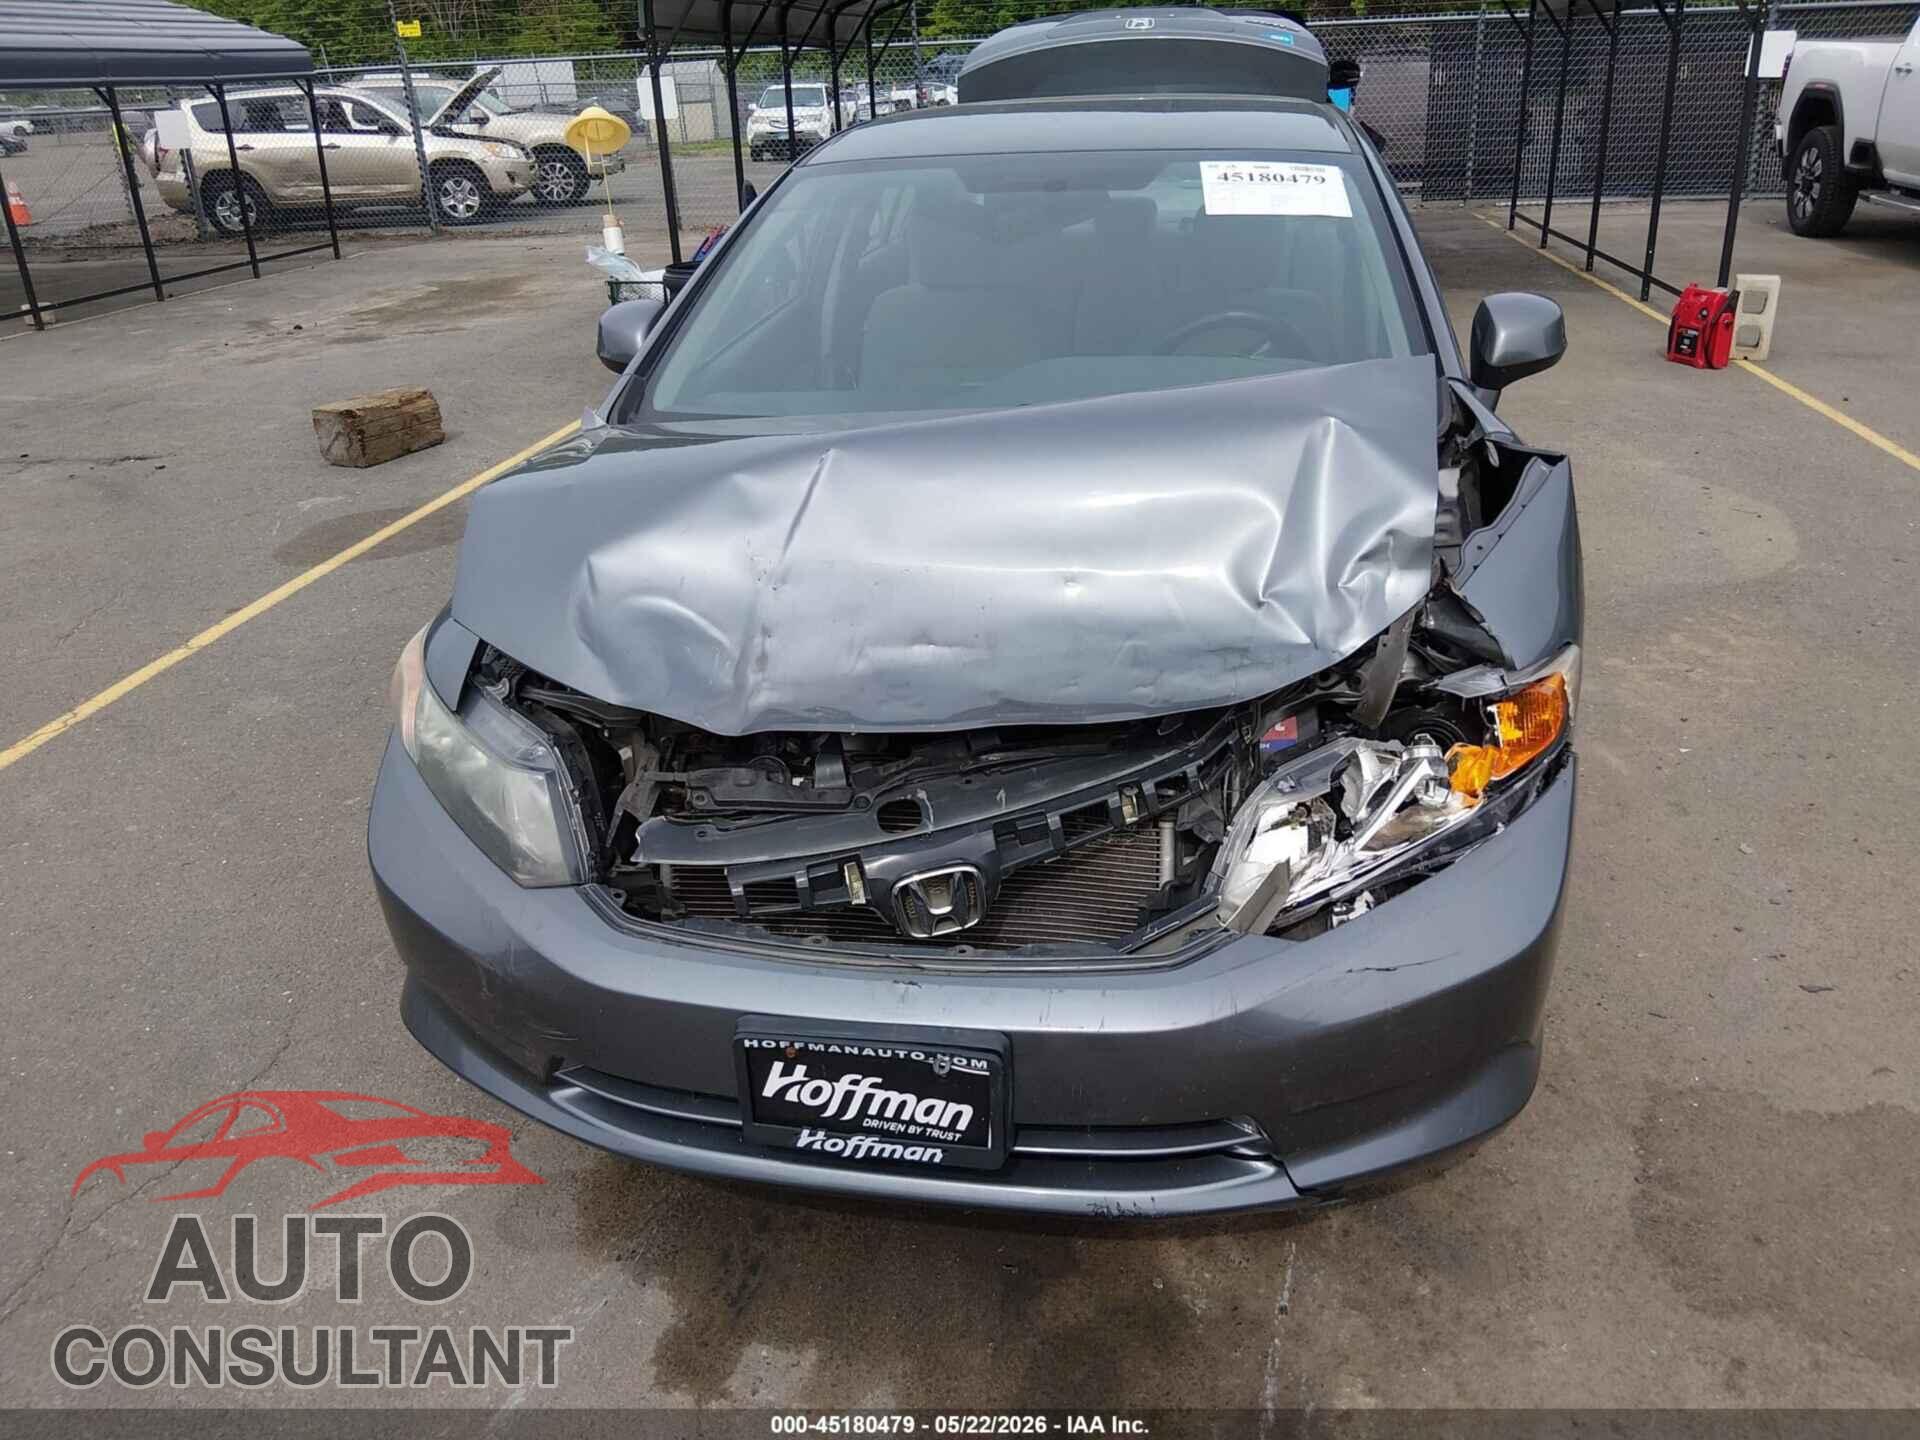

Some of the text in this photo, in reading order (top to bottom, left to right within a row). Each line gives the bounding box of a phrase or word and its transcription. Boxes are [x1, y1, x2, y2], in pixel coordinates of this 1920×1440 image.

[1217, 172, 1326, 184] 45180479
[761, 1061, 974, 1131] Hoffman
[862, 1118, 962, 1141] DRIVEN BY TRUST
[797, 1128, 943, 1163] Hoffman
